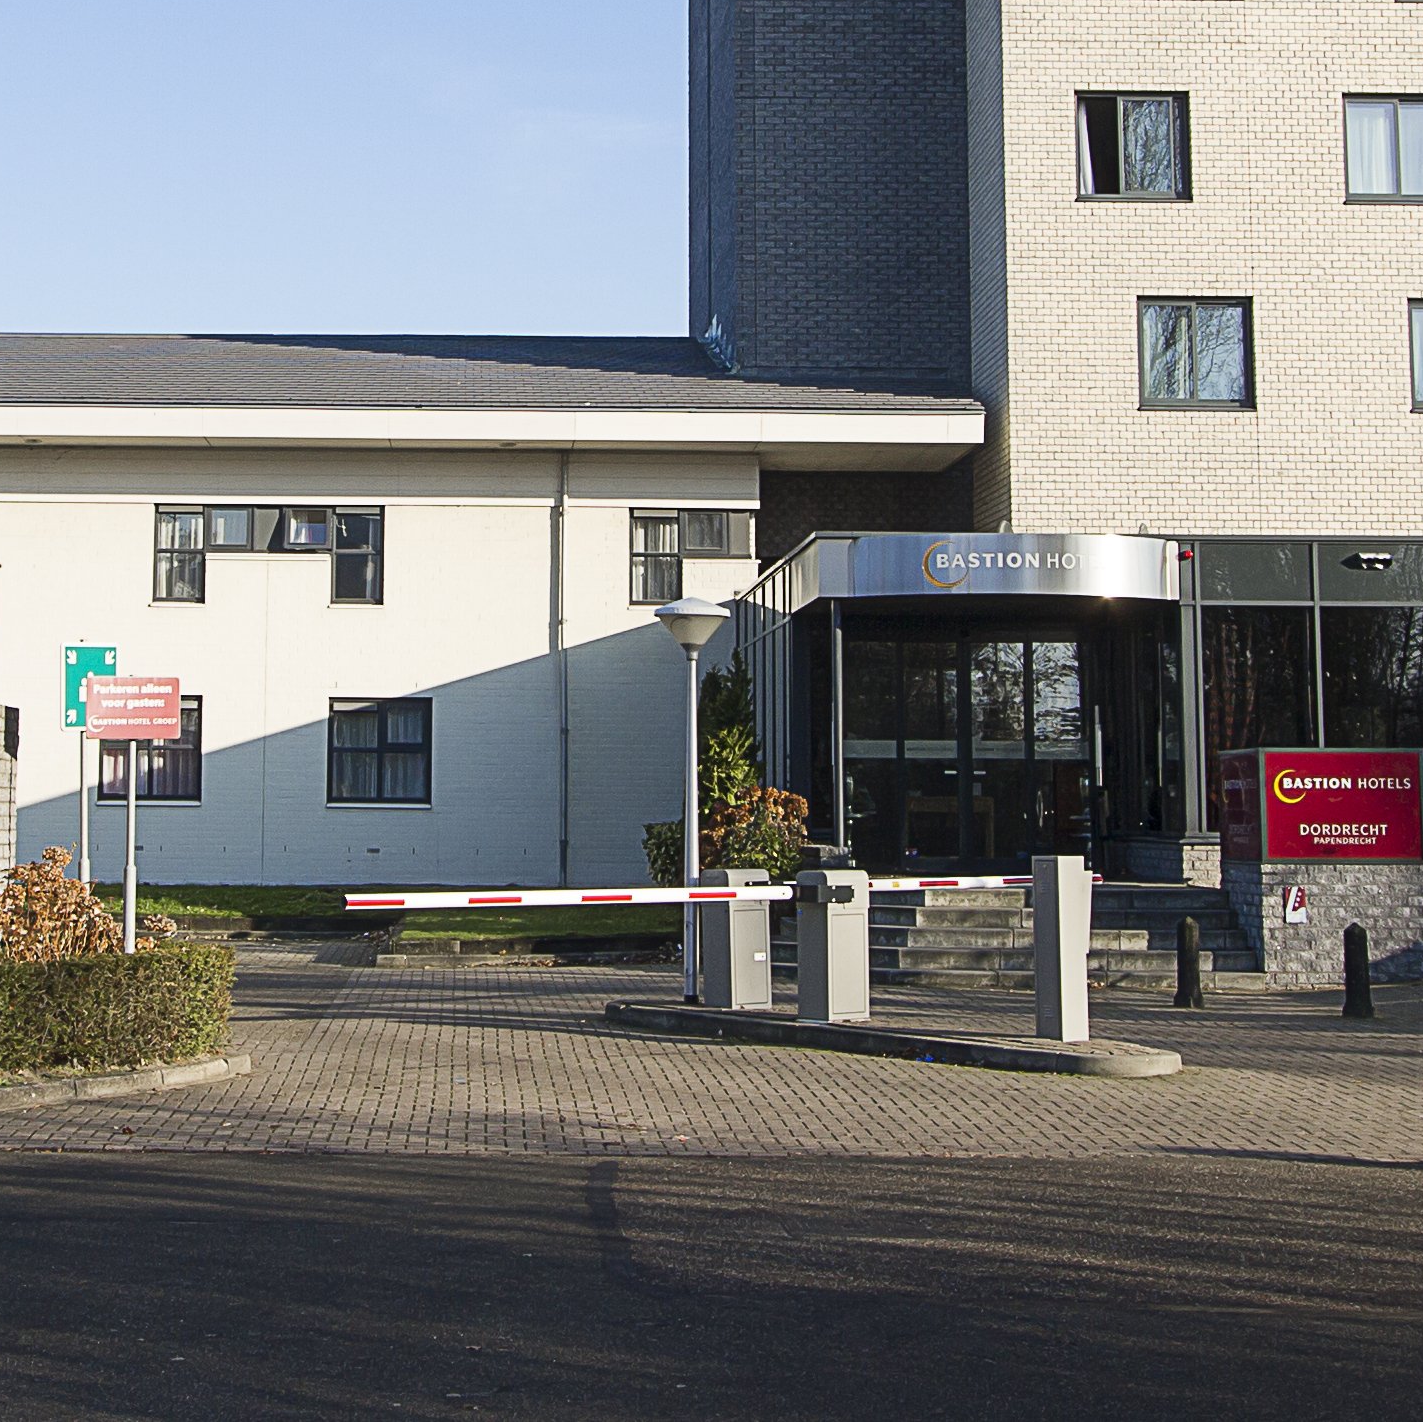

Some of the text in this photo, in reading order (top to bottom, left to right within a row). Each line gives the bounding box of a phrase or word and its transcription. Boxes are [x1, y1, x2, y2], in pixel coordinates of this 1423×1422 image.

[935, 552, 1040, 569] BASTION
[92, 683, 173, 694] Parkeren alleen
[100, 698, 126, 708] voor
[1282, 777, 1412, 789] BASTION HOTELS
[1299, 823, 1388, 836] DORDRECHT
[1313, 837, 1377, 845] PAPENDRECHT
